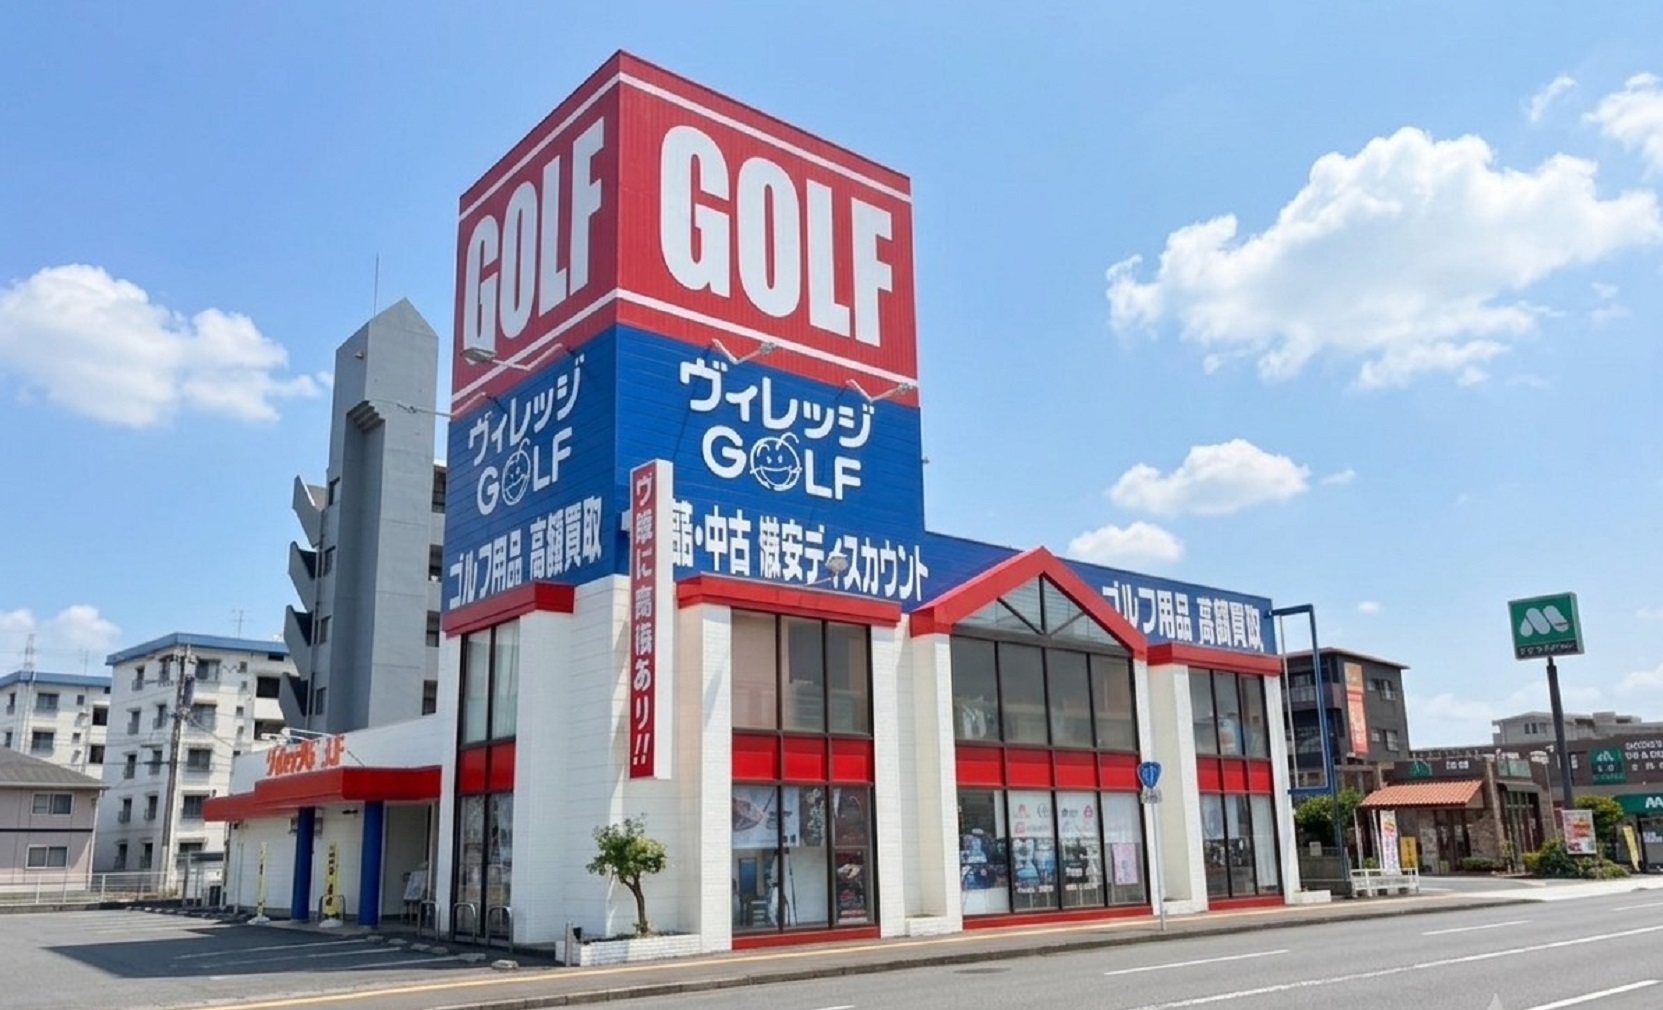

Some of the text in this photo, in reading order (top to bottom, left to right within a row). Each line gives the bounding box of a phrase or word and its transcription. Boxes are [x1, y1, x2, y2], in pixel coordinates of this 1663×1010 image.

[463, 116, 605, 353] GOLF
[660, 124, 893, 347] GOLF
[468, 353, 585, 467] ヴィレッジ
[679, 358, 875, 448] ヴィレッジ
[449, 528, 522, 610] ゴルフ用品
[1102, 580, 1193, 642] ゴルフ用品
